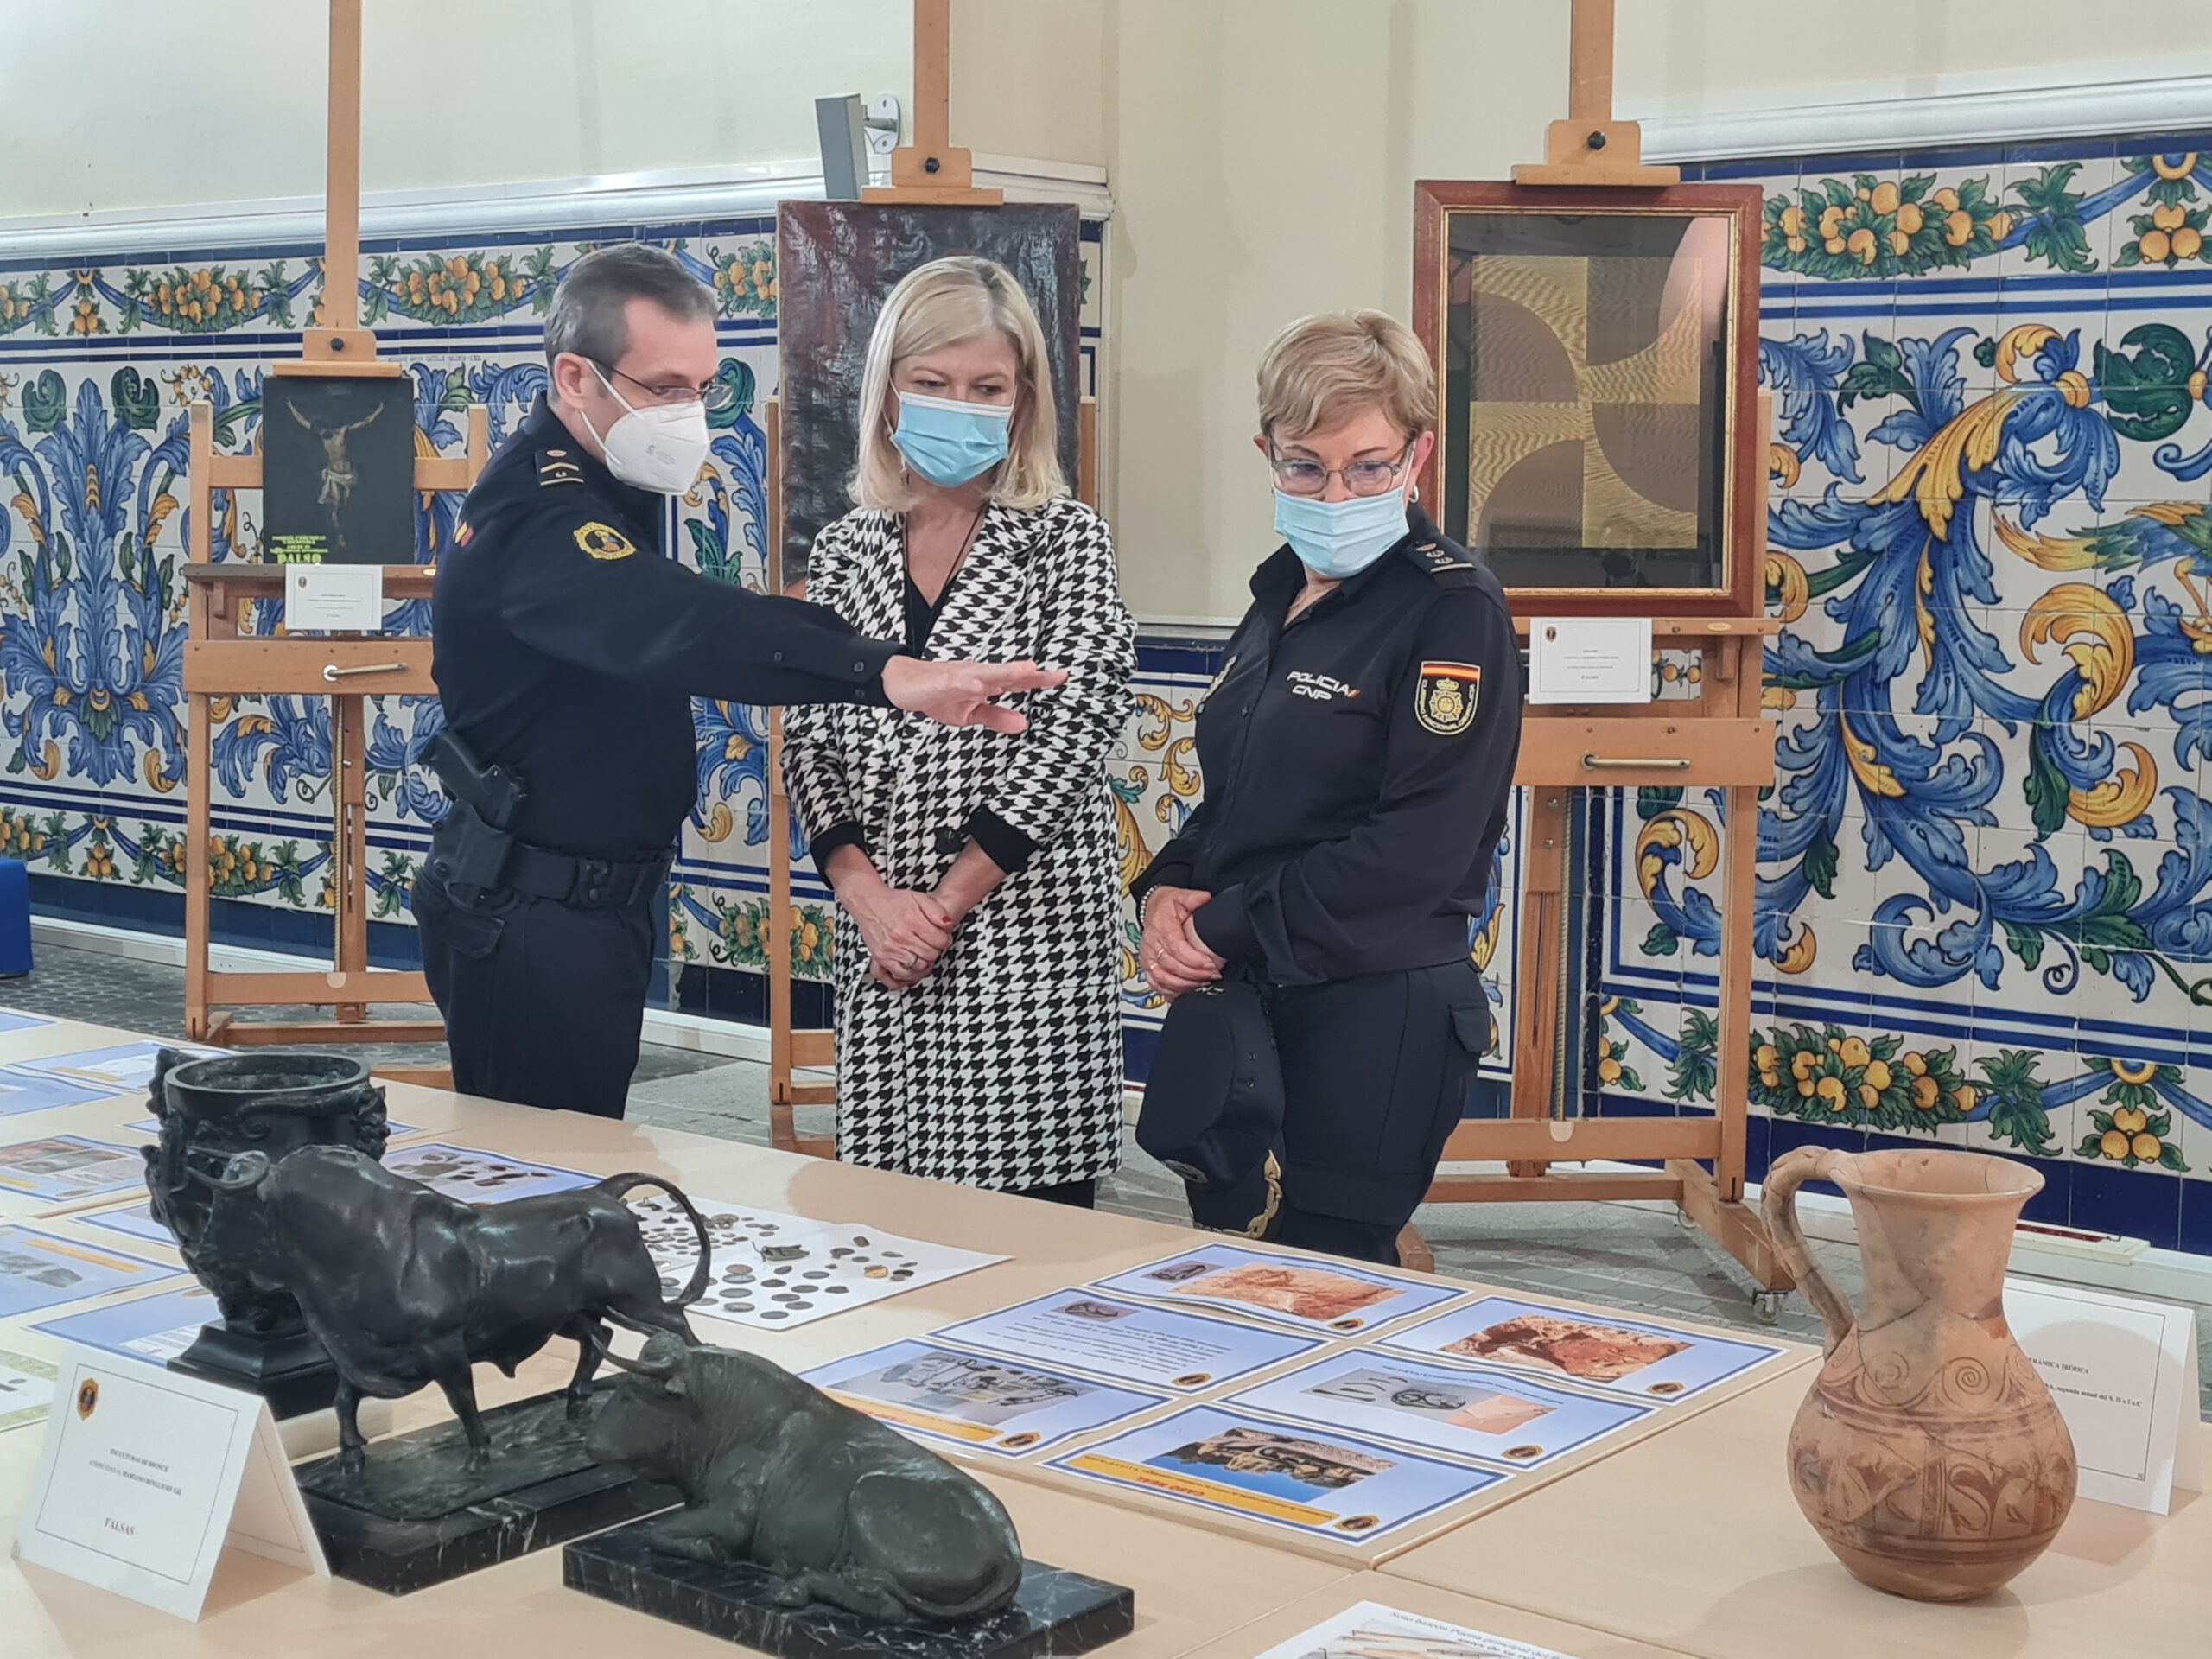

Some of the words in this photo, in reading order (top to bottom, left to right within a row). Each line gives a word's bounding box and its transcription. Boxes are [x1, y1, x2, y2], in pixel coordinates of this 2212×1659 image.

[1286, 671, 1350, 696] POLICIA
[1291, 684, 1332, 701] CNP
[104, 1517, 136, 1536] FALSAS
